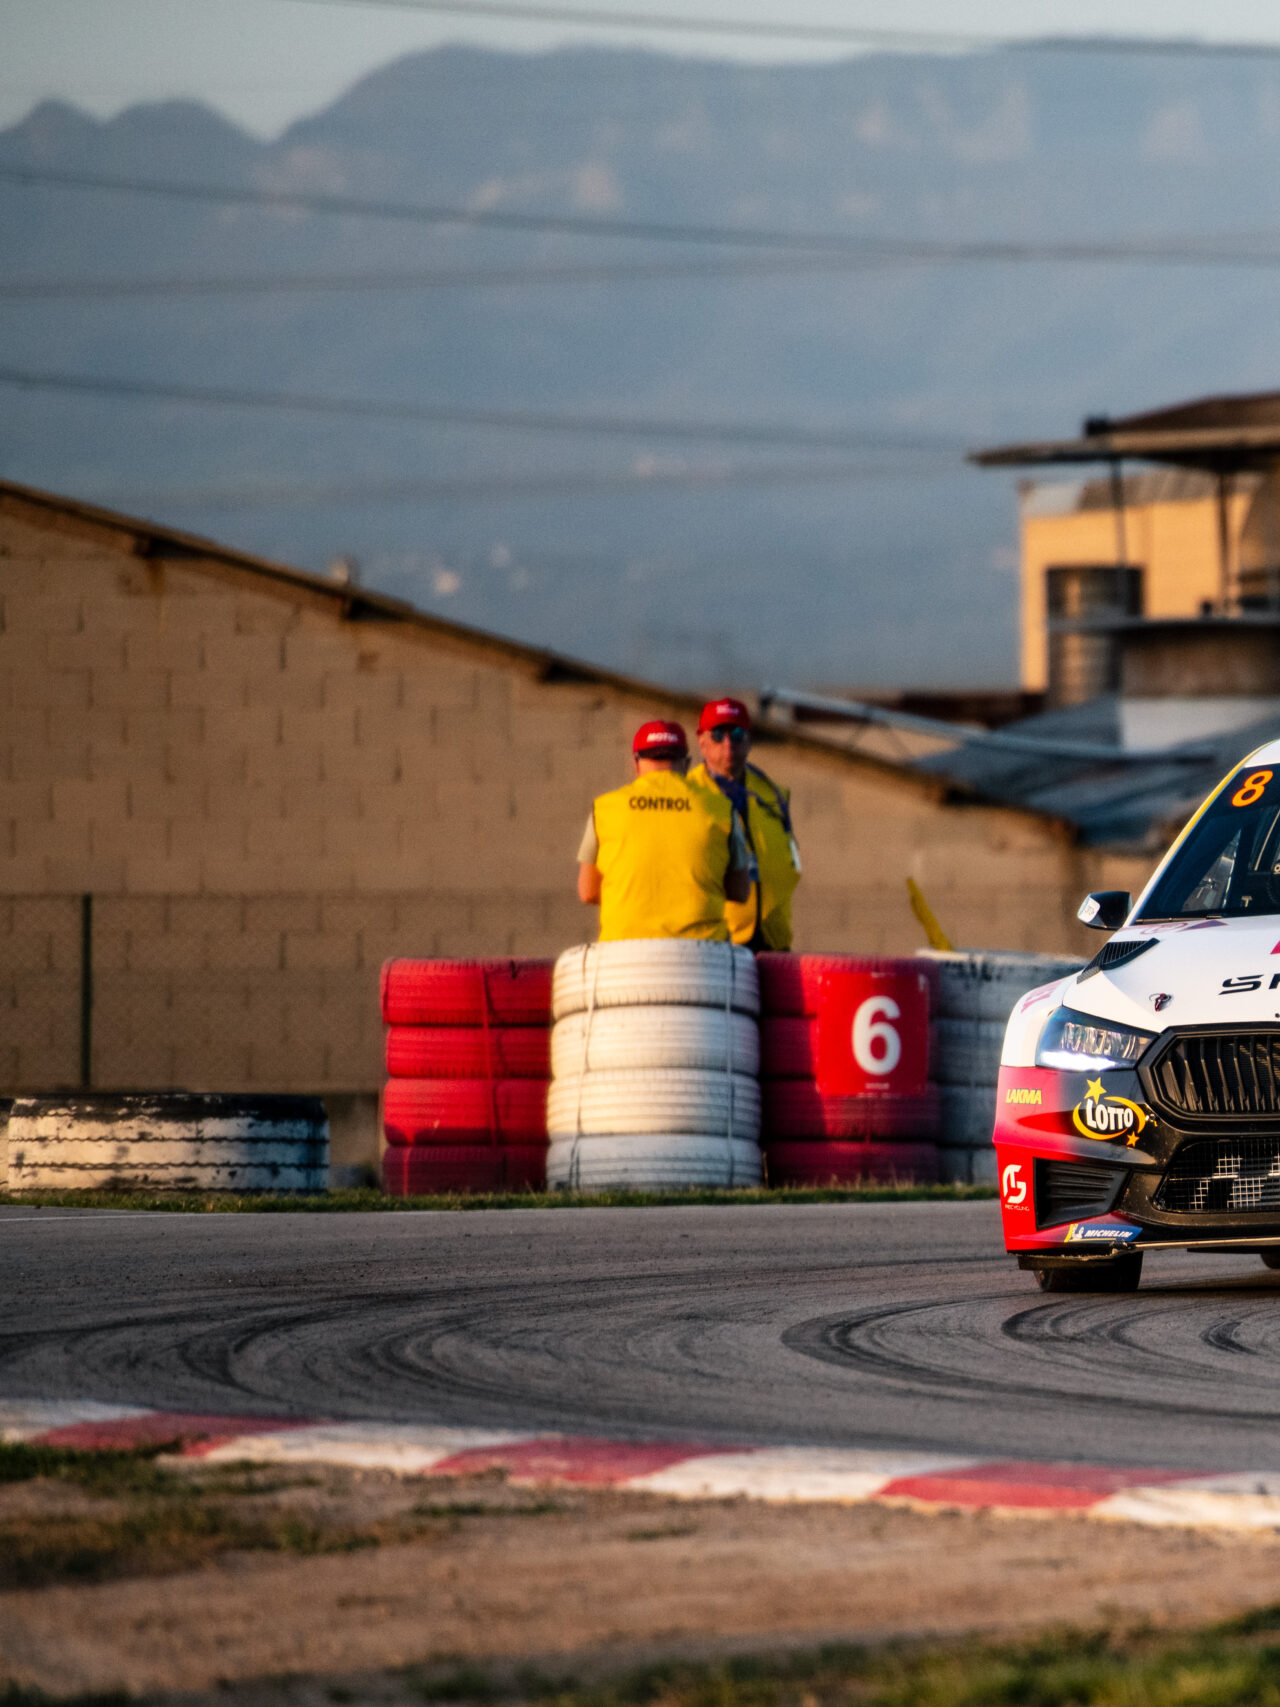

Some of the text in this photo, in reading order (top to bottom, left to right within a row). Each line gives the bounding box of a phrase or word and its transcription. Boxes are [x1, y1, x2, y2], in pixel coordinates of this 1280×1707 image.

[1231, 770, 1273, 807] 8
[628, 796, 692, 812] CONTROL
[852, 995, 901, 1076] 6
[1005, 1088, 1042, 1105] LAKMA
[1086, 1098, 1134, 1131] LOTTO
[1084, 1227, 1133, 1238] MICHELIN
